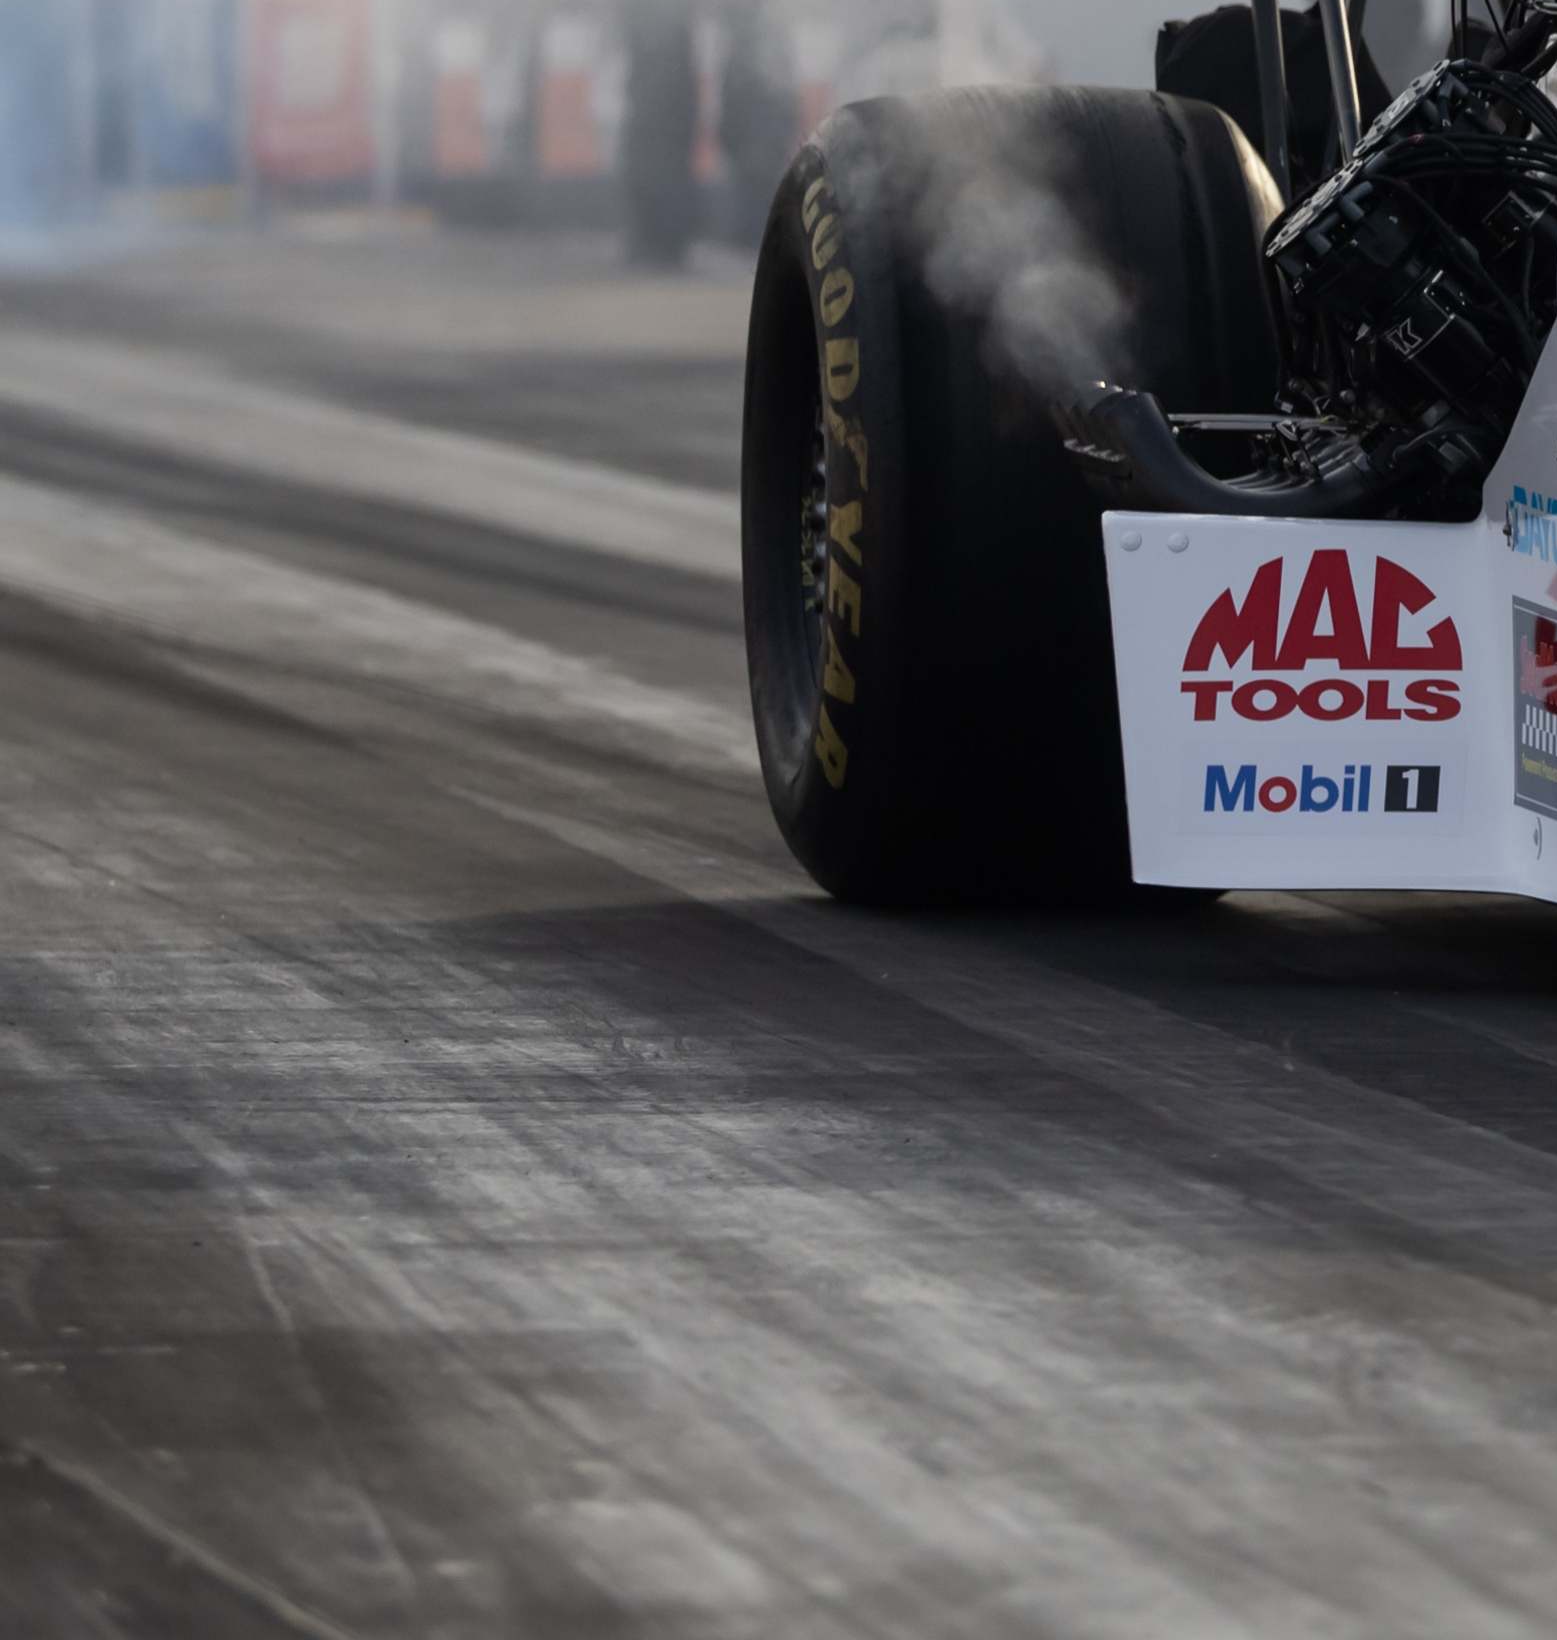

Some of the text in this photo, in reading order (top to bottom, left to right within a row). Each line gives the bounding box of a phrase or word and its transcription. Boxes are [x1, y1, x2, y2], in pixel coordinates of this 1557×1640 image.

[801, 174, 870, 791] GOODYEAR
[1182, 549, 1463, 671] MAC
[1180, 678, 1462, 722] TOOLS
[1203, 764, 1371, 812] Mobil
